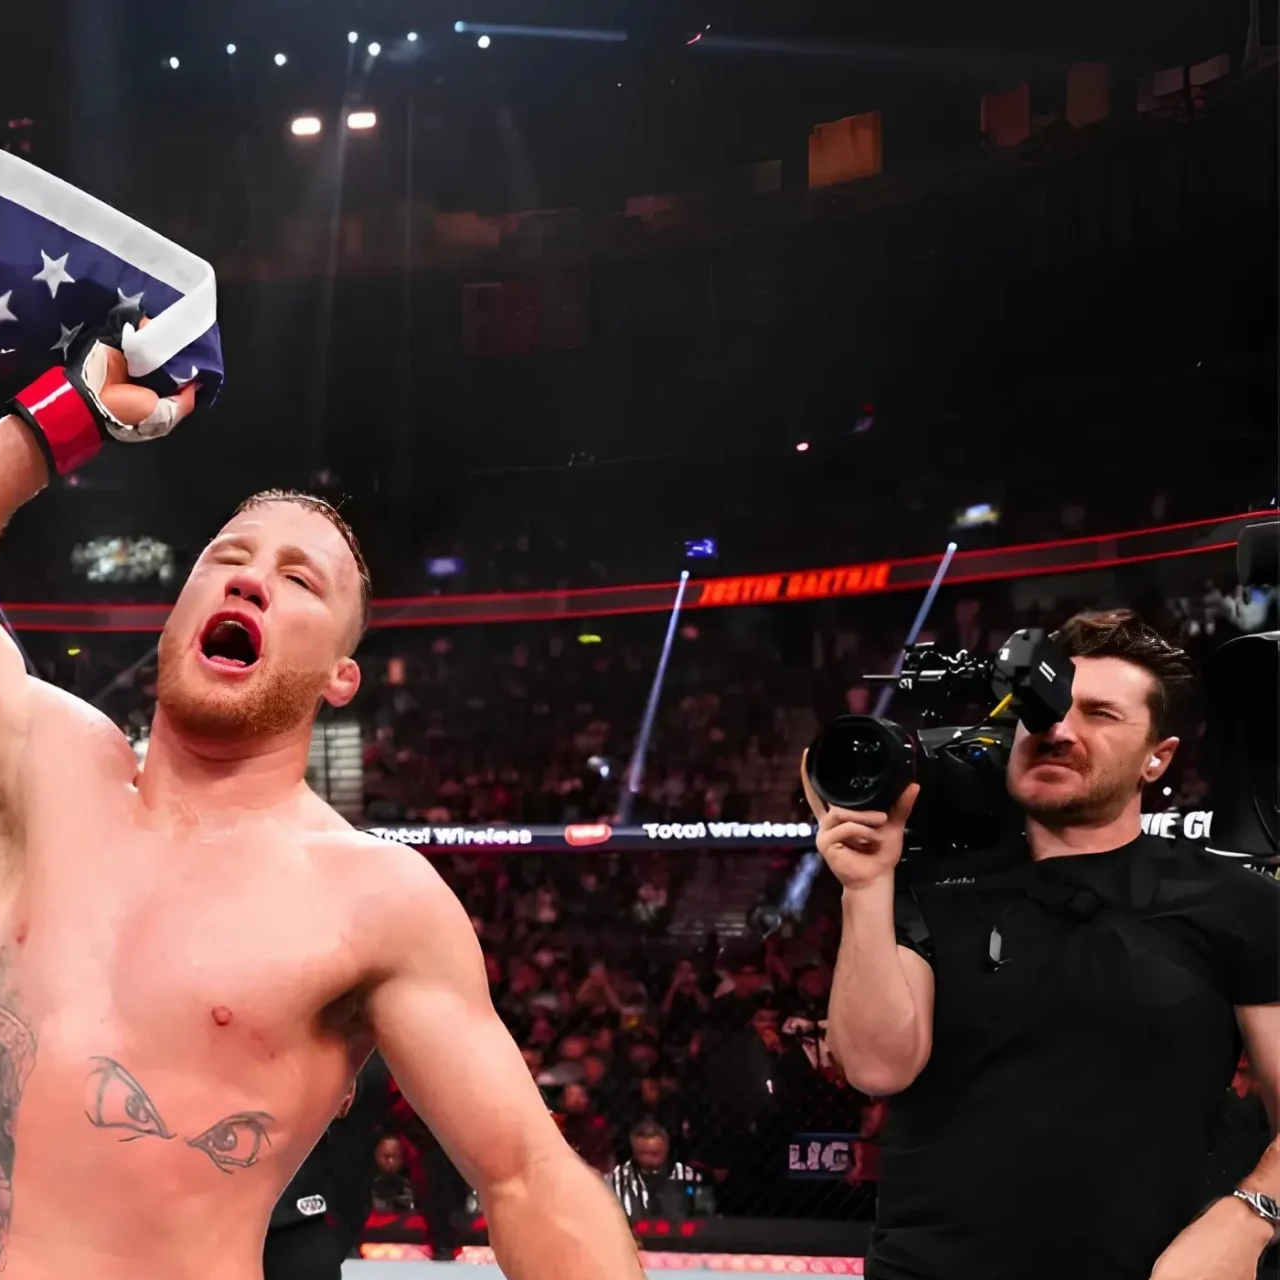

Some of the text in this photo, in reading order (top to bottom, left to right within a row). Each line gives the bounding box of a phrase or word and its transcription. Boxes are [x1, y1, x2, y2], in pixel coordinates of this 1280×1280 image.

[433, 826, 533, 845] Wireless
[642, 820, 812, 839] Total Wireless
